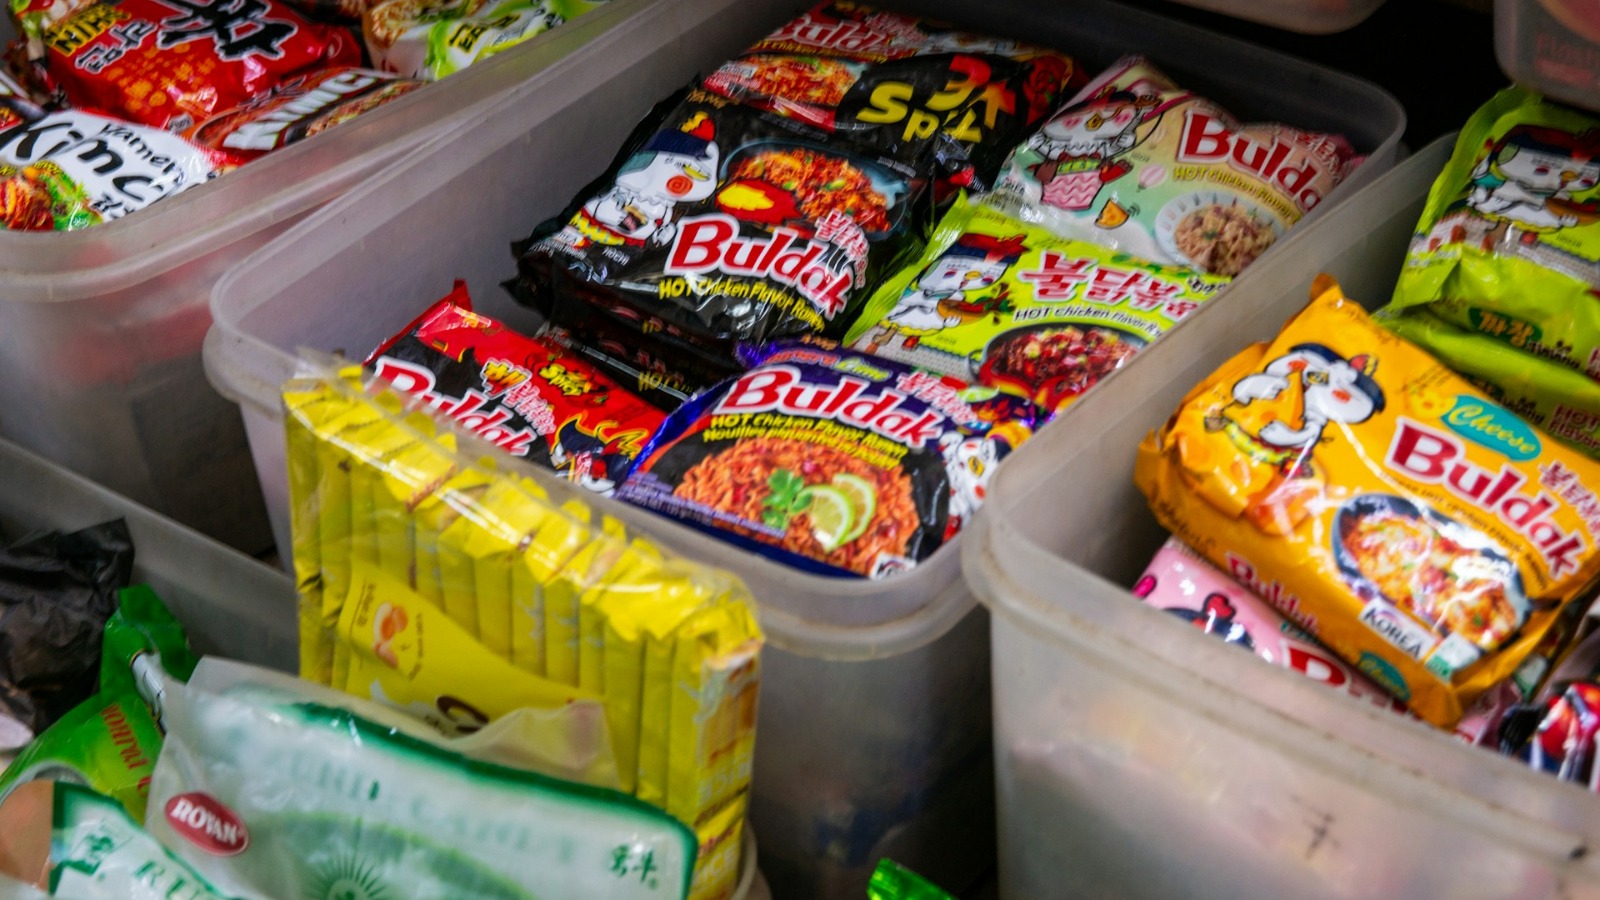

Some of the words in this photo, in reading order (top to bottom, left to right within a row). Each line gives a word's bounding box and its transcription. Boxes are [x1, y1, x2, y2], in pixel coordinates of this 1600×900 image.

[663, 213, 853, 322] Buldak
[658, 277, 694, 301] HOT
[749, 279, 795, 311] Flavor
[1014, 308, 1052, 323] HOT
[710, 413, 754, 430] HOT
[813, 418, 864, 442] Flavor
[714, 363, 946, 450] Buldak
[1448, 404, 1538, 454] Cheese
[1384, 415, 1586, 582] Buldak
[1364, 607, 1423, 659] KOREA
